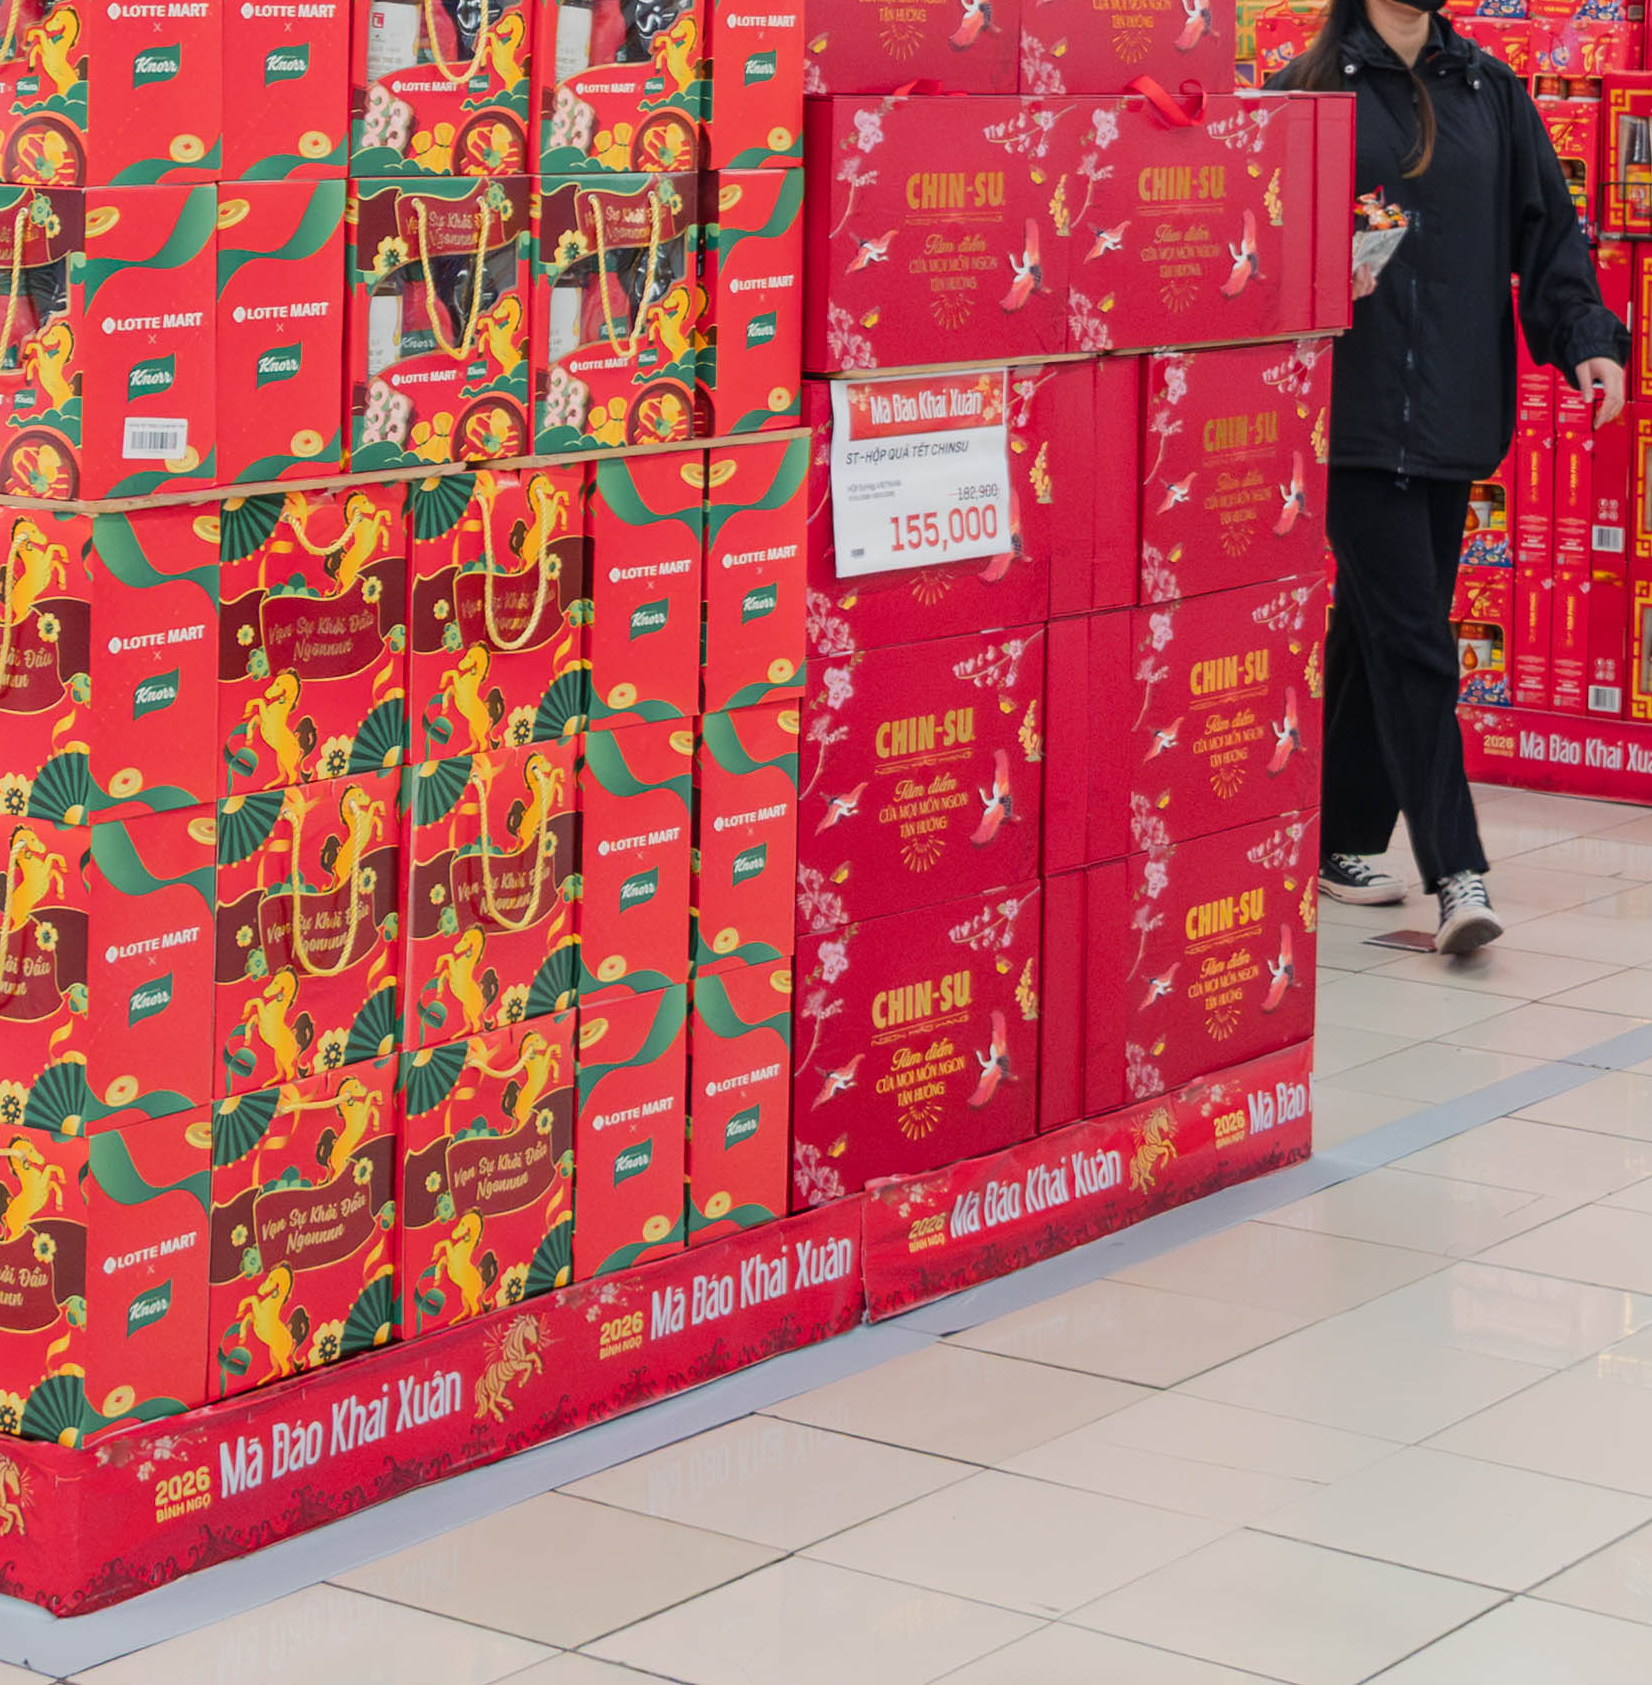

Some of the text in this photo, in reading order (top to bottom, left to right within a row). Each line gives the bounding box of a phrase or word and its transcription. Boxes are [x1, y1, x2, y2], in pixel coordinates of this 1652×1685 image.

[120, 3, 208, 17] LOTTE MART
[136, 57, 177, 73] Knorr
[891, 504, 997, 551] 155,000
[729, 545, 797, 567] LOTTE MART
[744, 596, 775, 610] Knorr
[872, 971, 971, 1028] CHIN-SU
[951, 1149, 1121, 1238] Mã Đáo Khai Xuân
[651, 1237, 852, 1339] Mã Đáo Khai Xuân
[600, 1311, 643, 1345] 2026
[220, 1371, 461, 1498] Mã Đáo Khai Xuân
[156, 1466, 210, 1506] 2026
